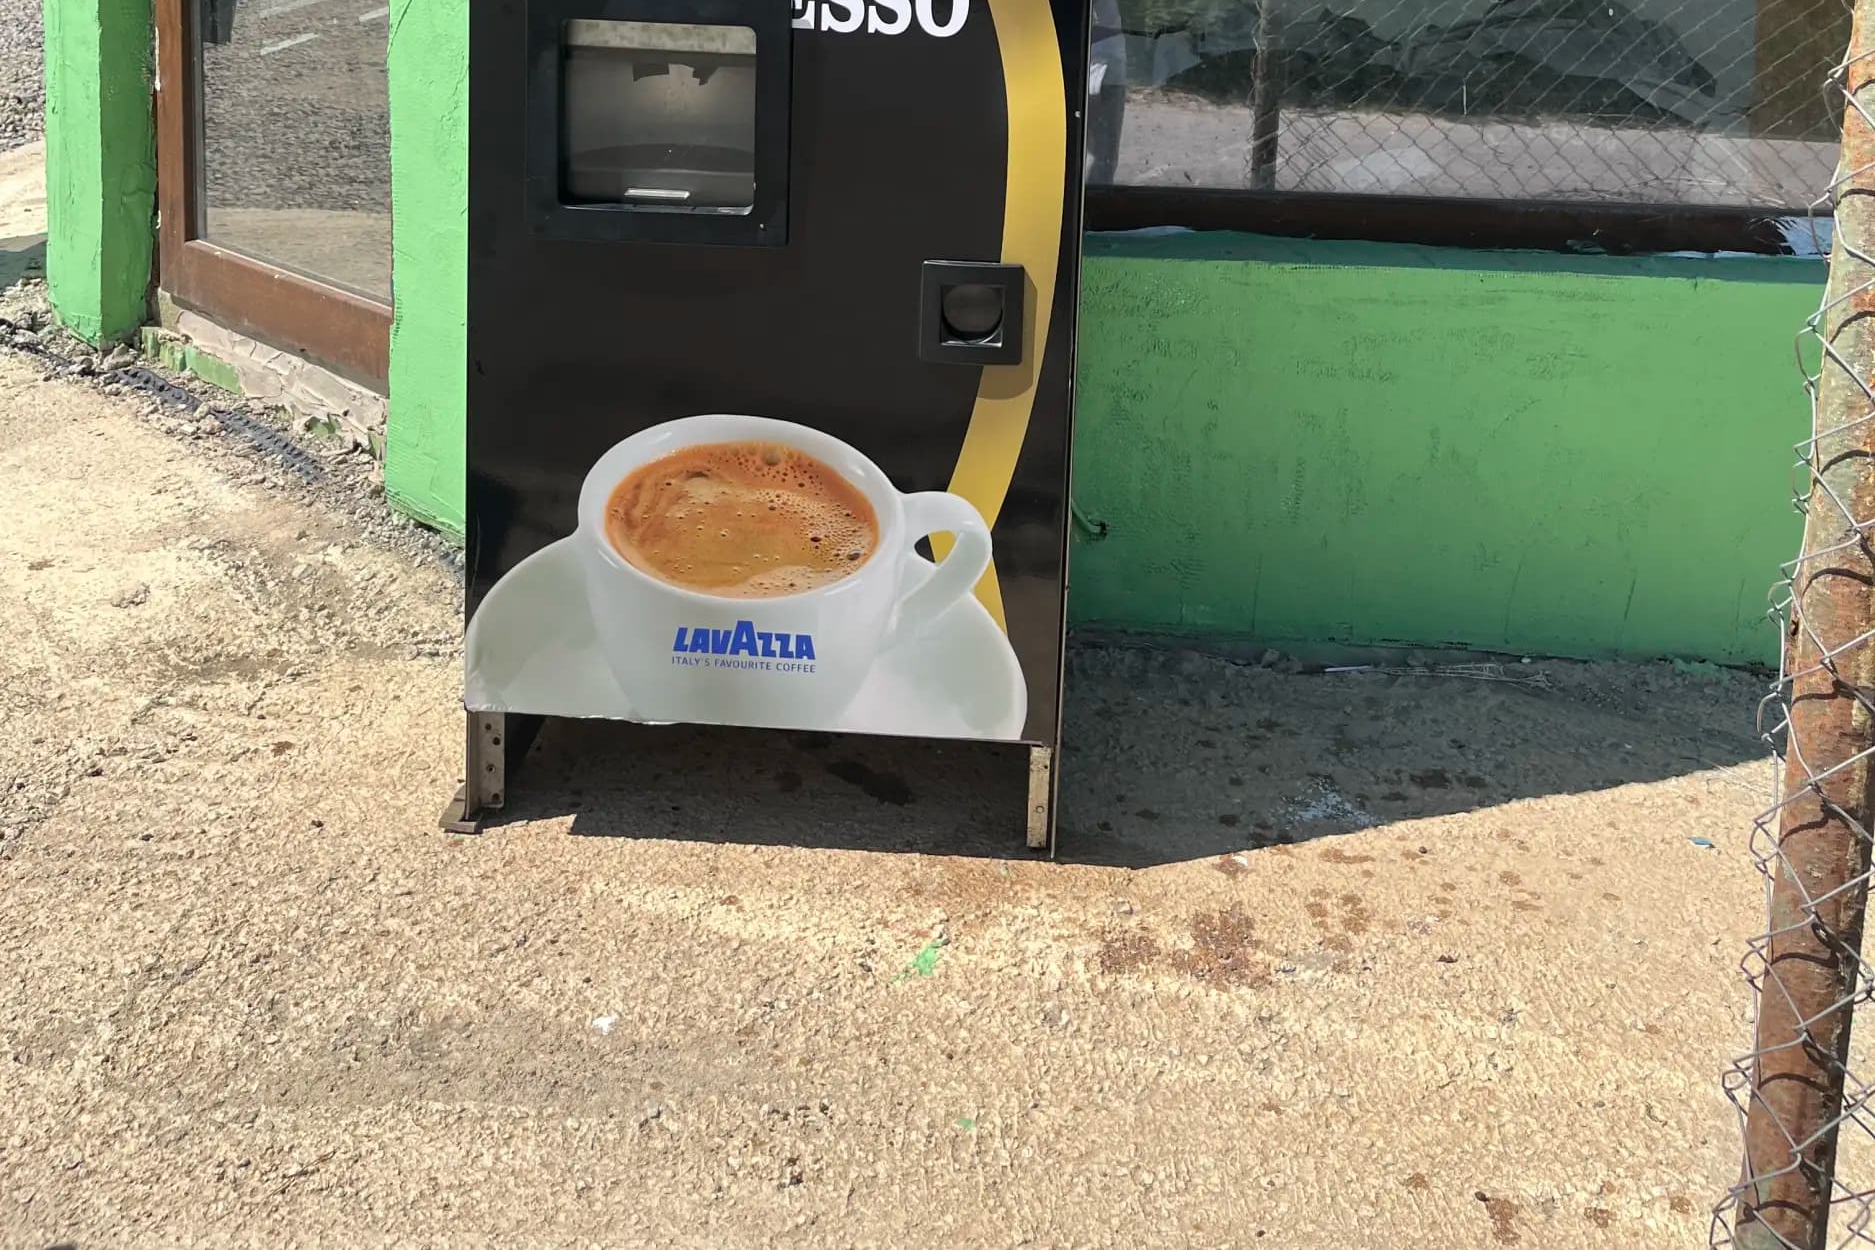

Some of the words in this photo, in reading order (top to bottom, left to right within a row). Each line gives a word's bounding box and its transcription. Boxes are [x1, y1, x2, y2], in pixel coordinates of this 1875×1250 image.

[672, 619, 816, 661] LAVAZZA
[671, 655, 711, 668] ITALY'S
[714, 658, 772, 671] FAVOURITE
[775, 661, 816, 674] COFFEE
